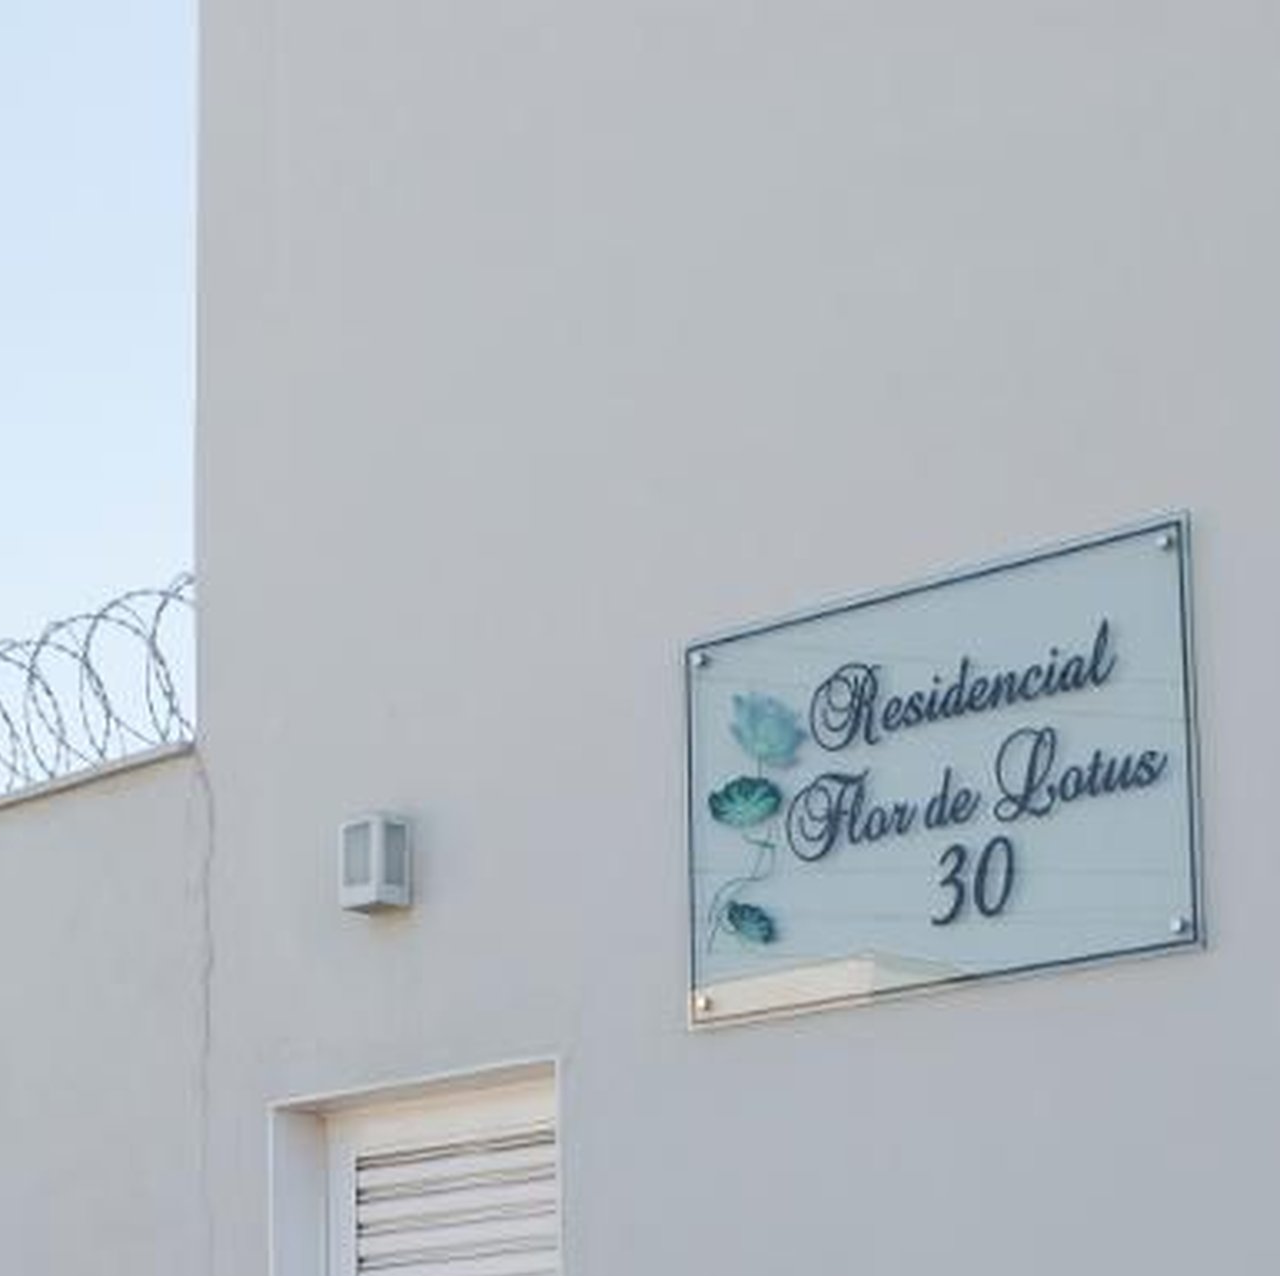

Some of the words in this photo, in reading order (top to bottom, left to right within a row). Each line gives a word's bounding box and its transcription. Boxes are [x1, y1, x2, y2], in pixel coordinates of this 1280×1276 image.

[810, 617, 1118, 752] Residencial
[786, 767, 915, 862] Flor
[923, 766, 982, 830] de
[993, 726, 1168, 823] Lotus
[930, 835, 1016, 927] 30
